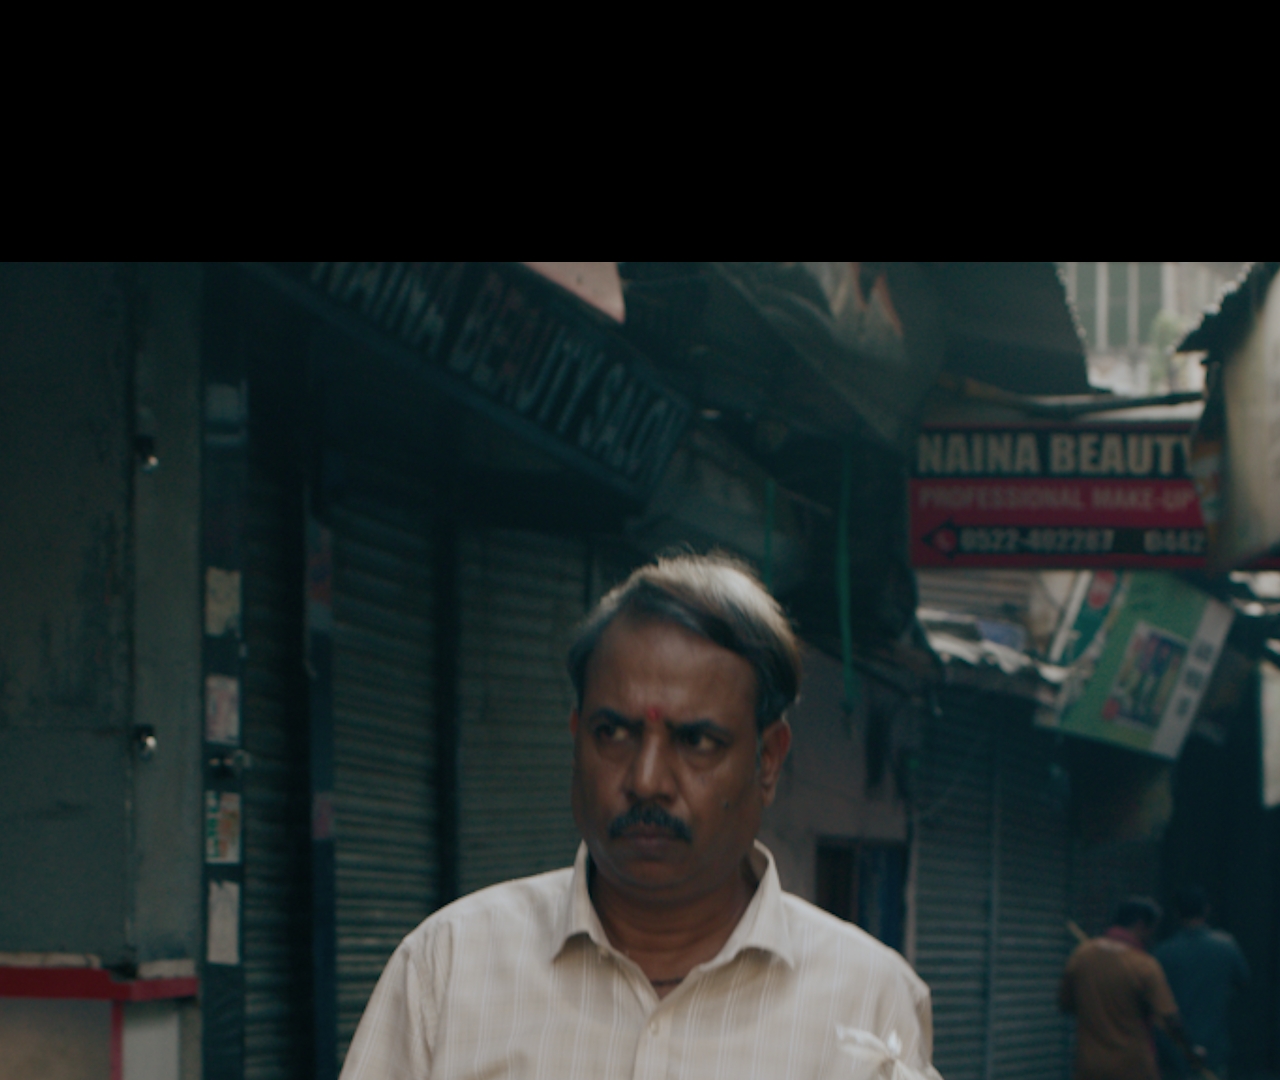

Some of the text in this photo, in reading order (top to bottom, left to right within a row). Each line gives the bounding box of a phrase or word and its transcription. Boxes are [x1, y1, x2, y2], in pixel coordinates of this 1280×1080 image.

[448, 272, 606, 435] BEAUTY
[918, 432, 1040, 475] NAINA
[920, 484, 1085, 512] PROFESSIONAL
